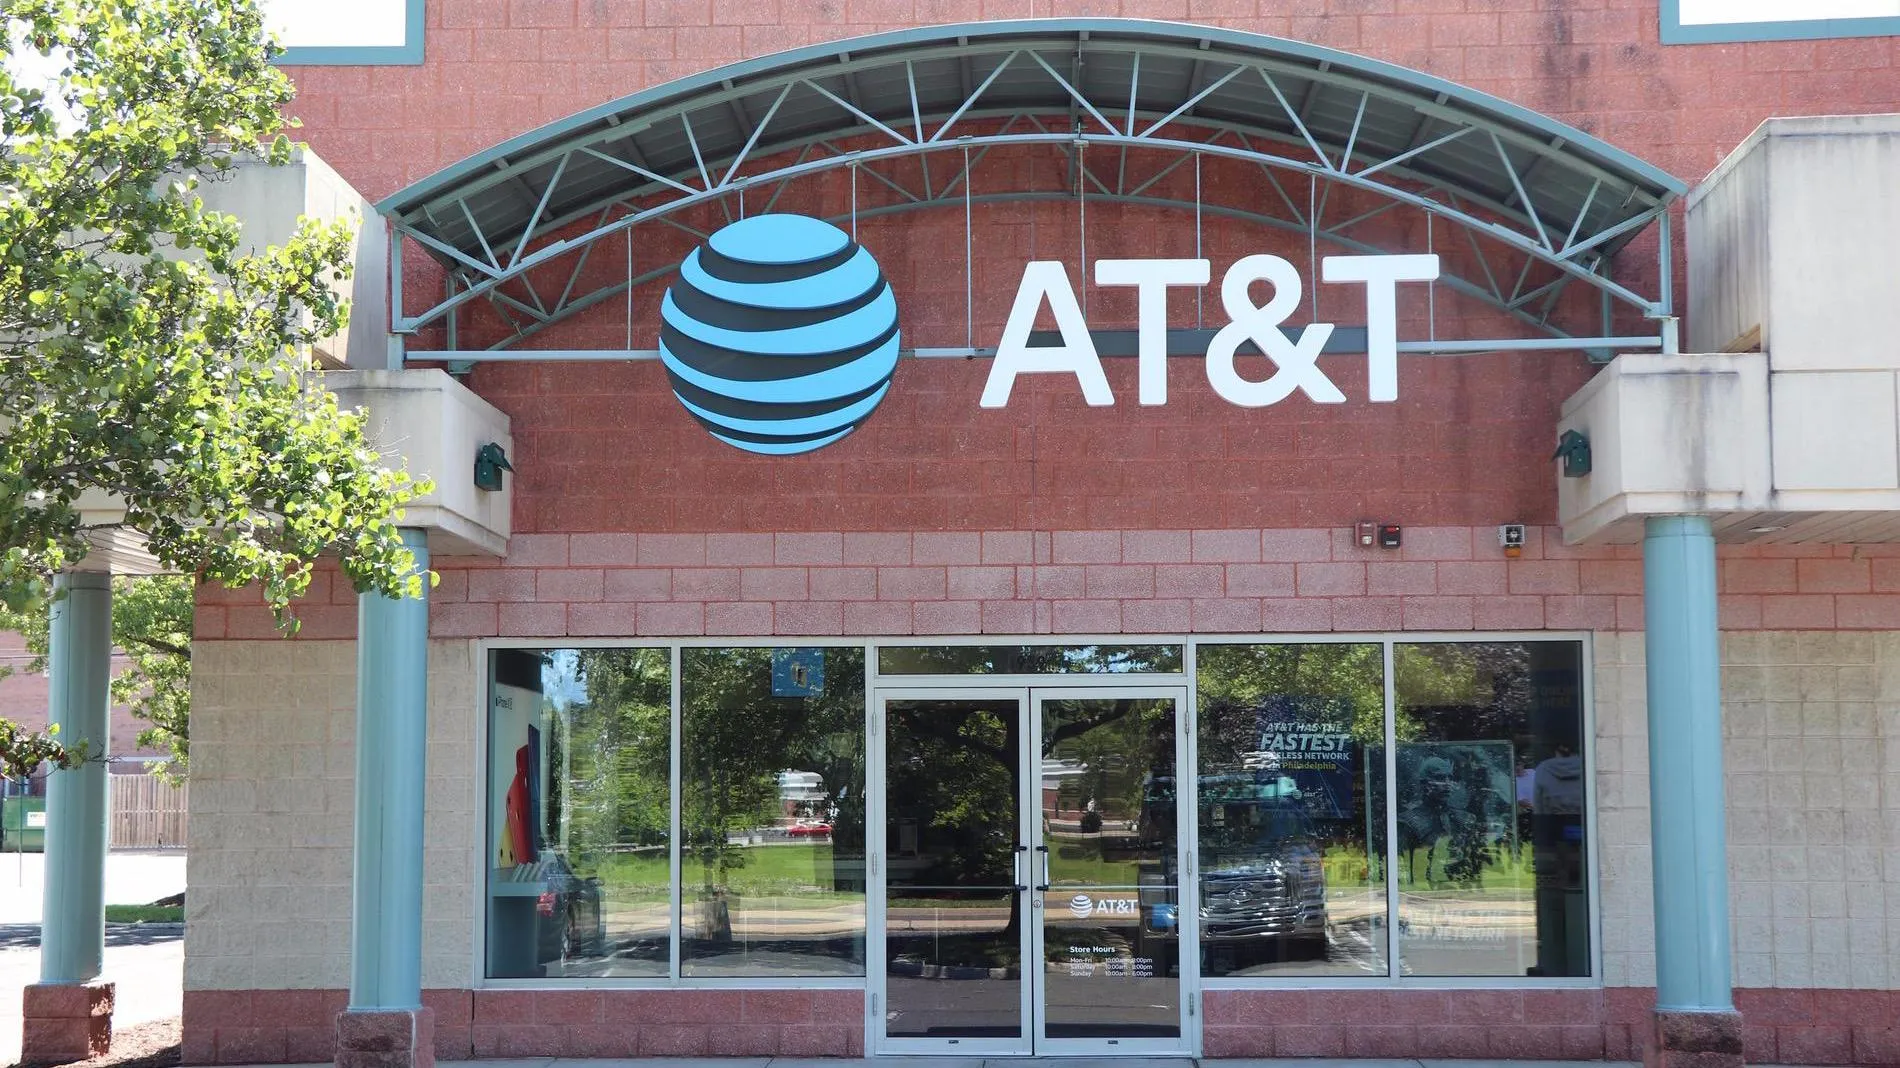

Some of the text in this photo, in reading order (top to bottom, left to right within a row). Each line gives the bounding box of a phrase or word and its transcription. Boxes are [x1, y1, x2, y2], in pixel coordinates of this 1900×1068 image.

[980, 254, 1440, 407] AT&T
[1266, 723, 1343, 733] AT&T HAS THE
[1260, 733, 1351, 751] FASTEST
[1304, 752, 1350, 760] NETWORK
[1282, 762, 1337, 771] Philadelphia
[1096, 899, 1138, 914] AT&T
